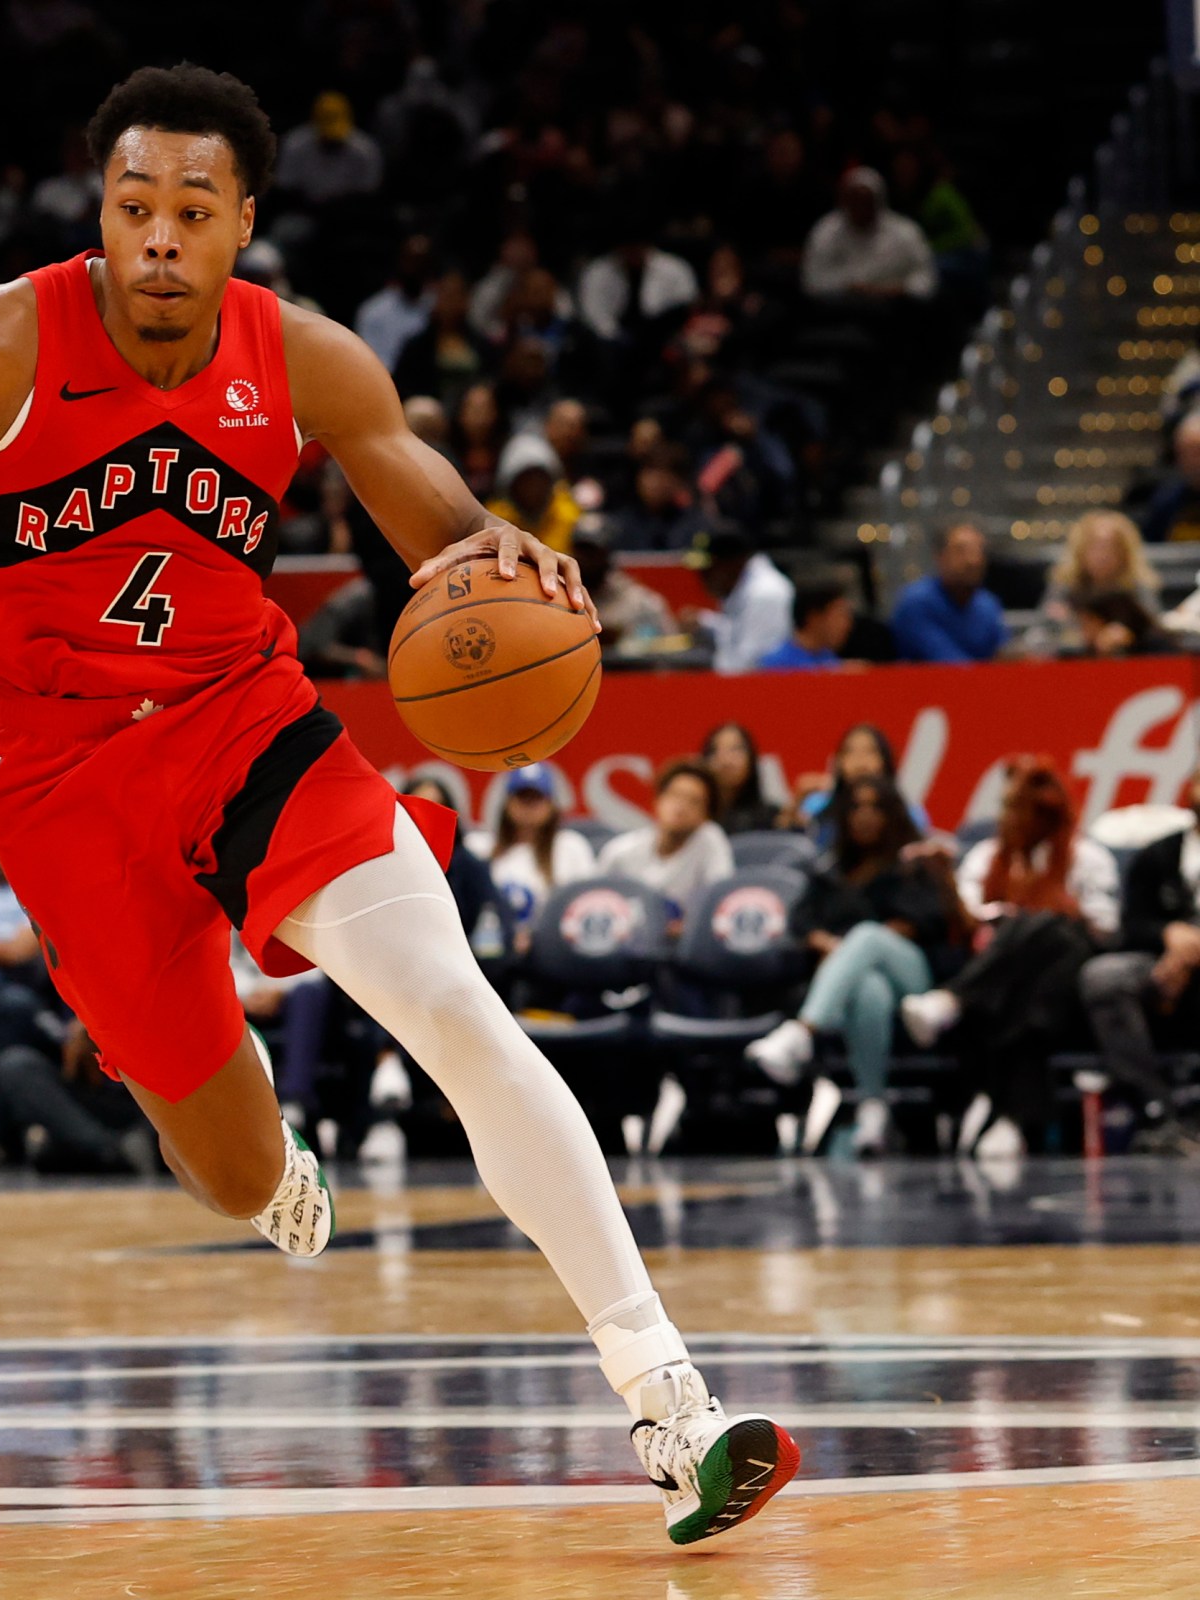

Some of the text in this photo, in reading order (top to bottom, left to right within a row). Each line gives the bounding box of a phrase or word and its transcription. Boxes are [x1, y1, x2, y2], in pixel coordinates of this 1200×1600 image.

[218, 413, 270, 428] Sun Life
[15, 448, 269, 555] RAPTORS
[99, 551, 176, 647] 4
